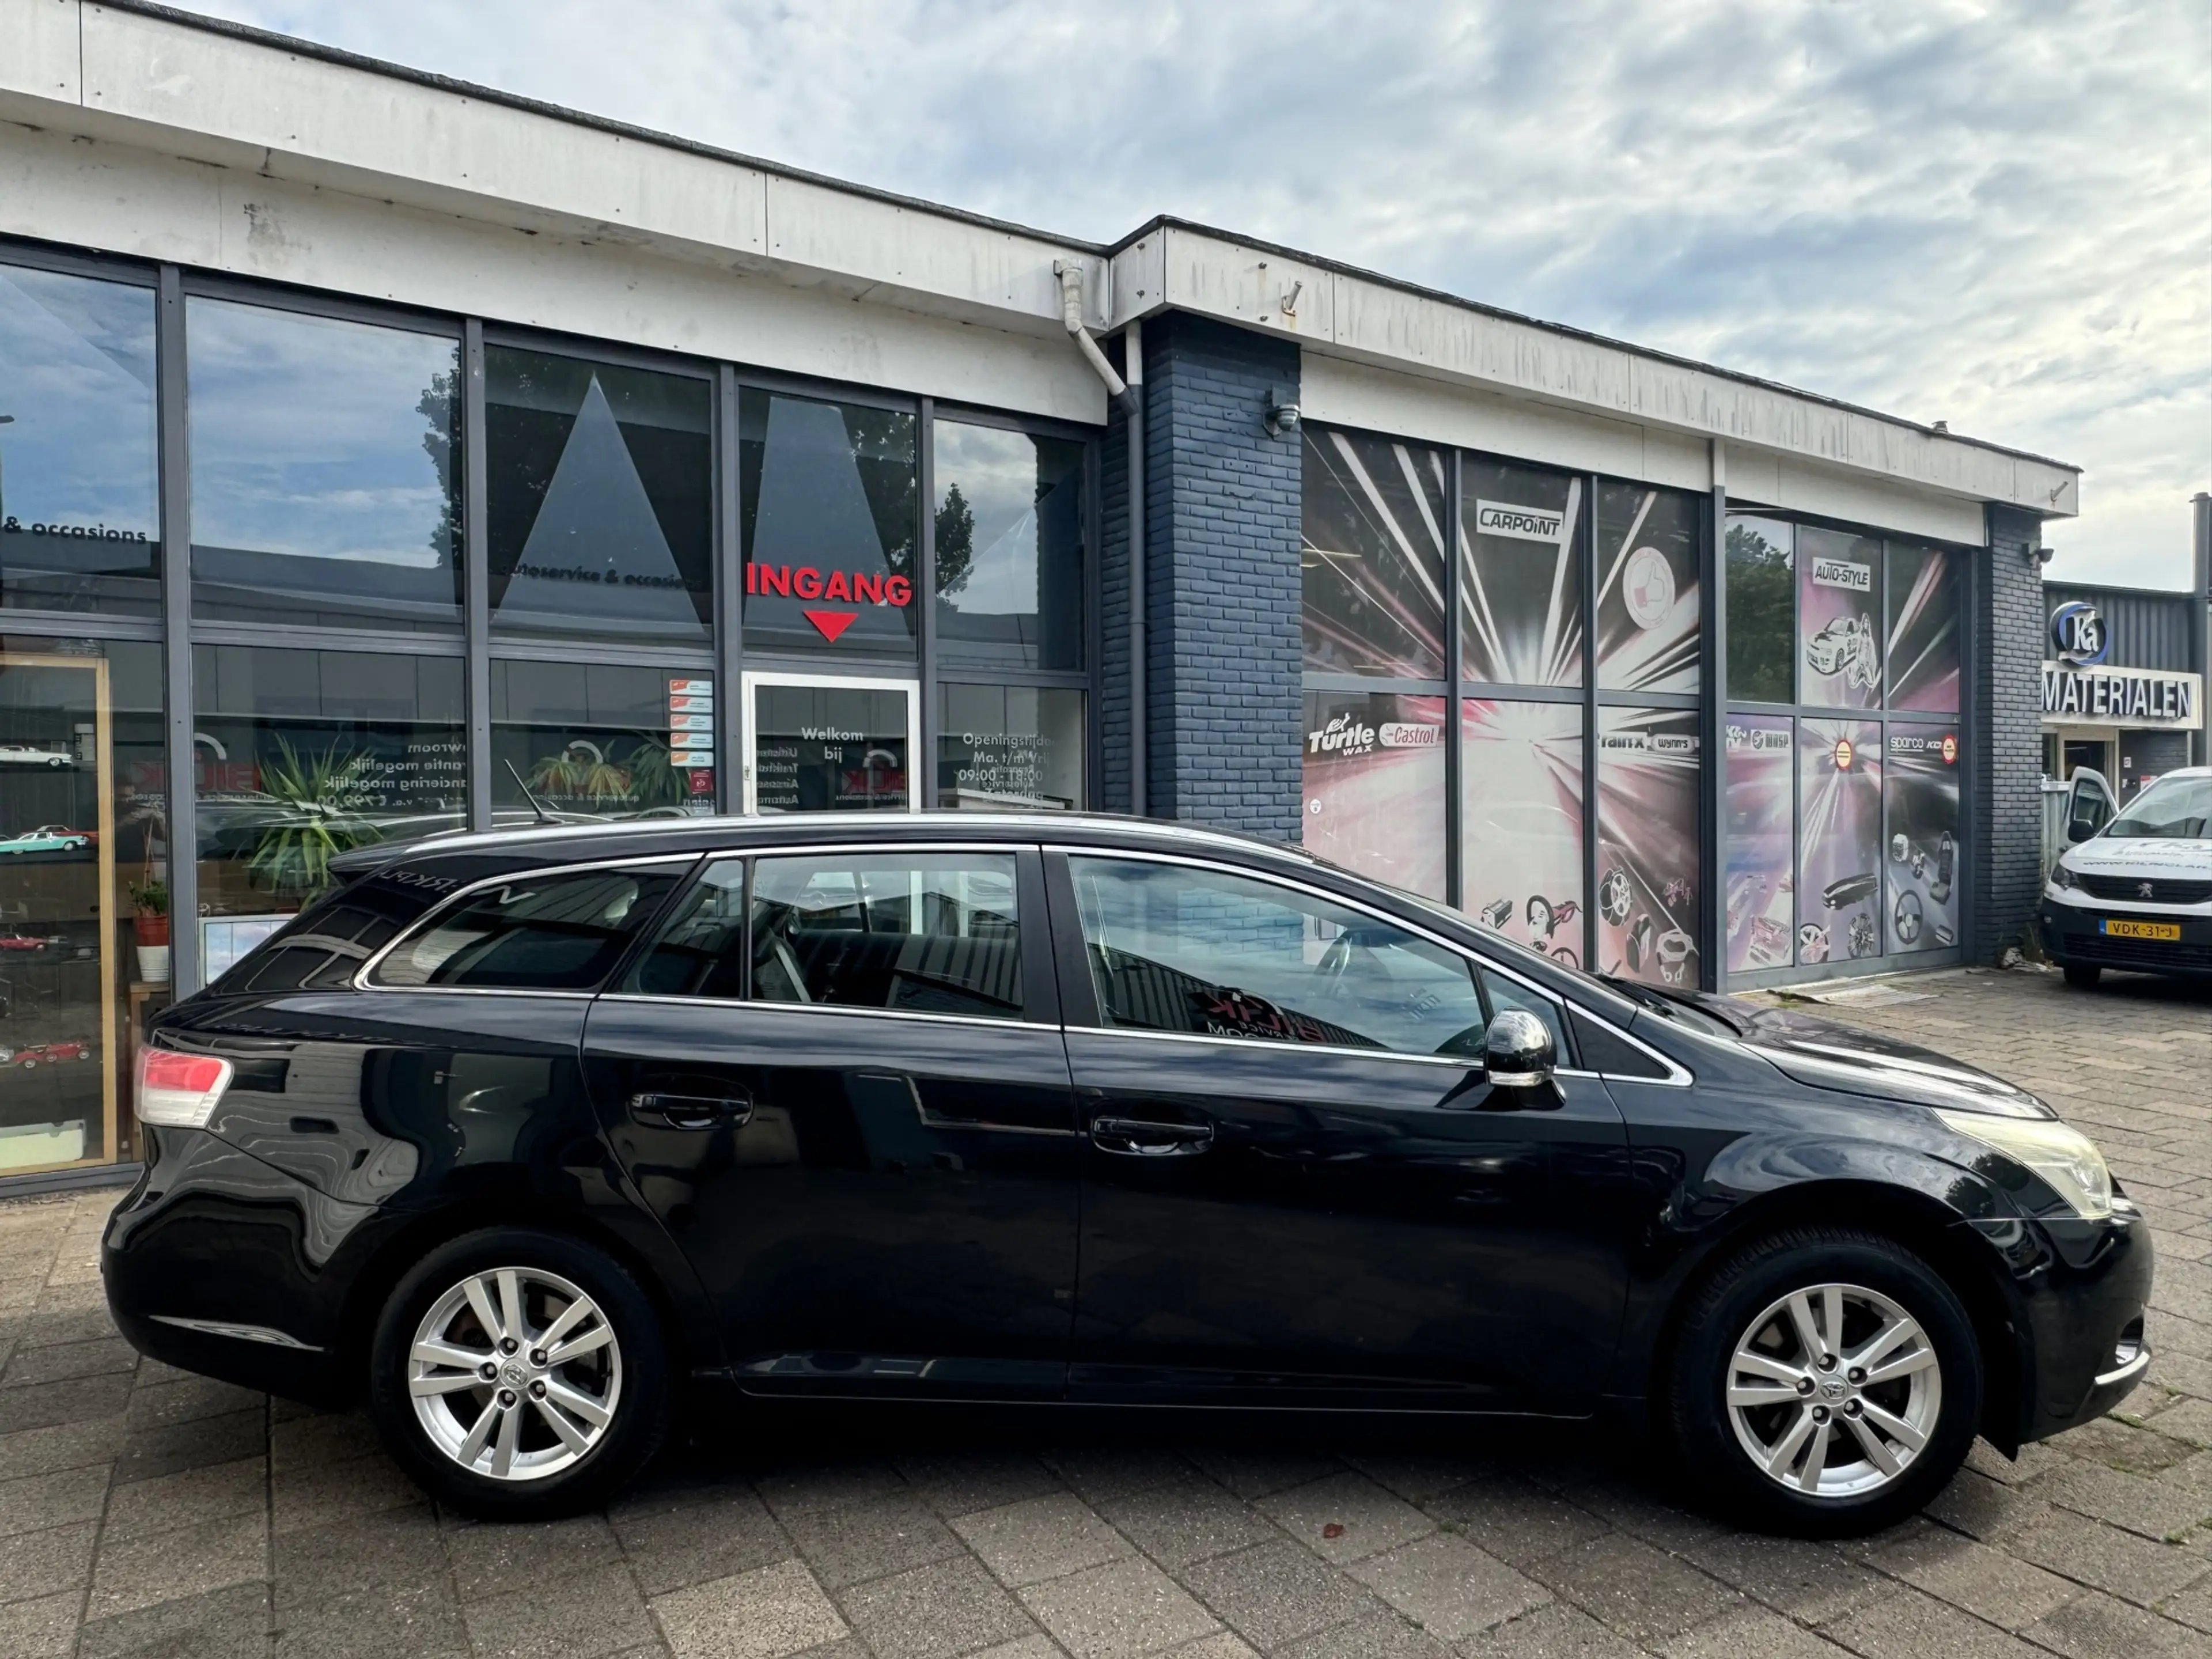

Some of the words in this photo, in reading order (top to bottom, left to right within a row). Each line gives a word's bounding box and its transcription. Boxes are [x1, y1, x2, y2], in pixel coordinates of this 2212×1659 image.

[3, 516, 22, 534] &
[31, 522, 146, 544] occasions
[1815, 562, 1869, 586] AUTO-STYLE
[747, 562, 912, 606] INGANG
[2041, 671, 2191, 718] MATERIALEN
[801, 726, 863, 741] Welkom
[1309, 722, 1376, 753] Turtle
[1393, 726, 1435, 744] Castrol
[824, 747, 842, 764] bij
[974, 751, 998, 763] Ma.
[1002, 751, 1025, 765] t/m
[1343, 744, 1373, 756] WAX
[959, 769, 997, 781] 09:00
